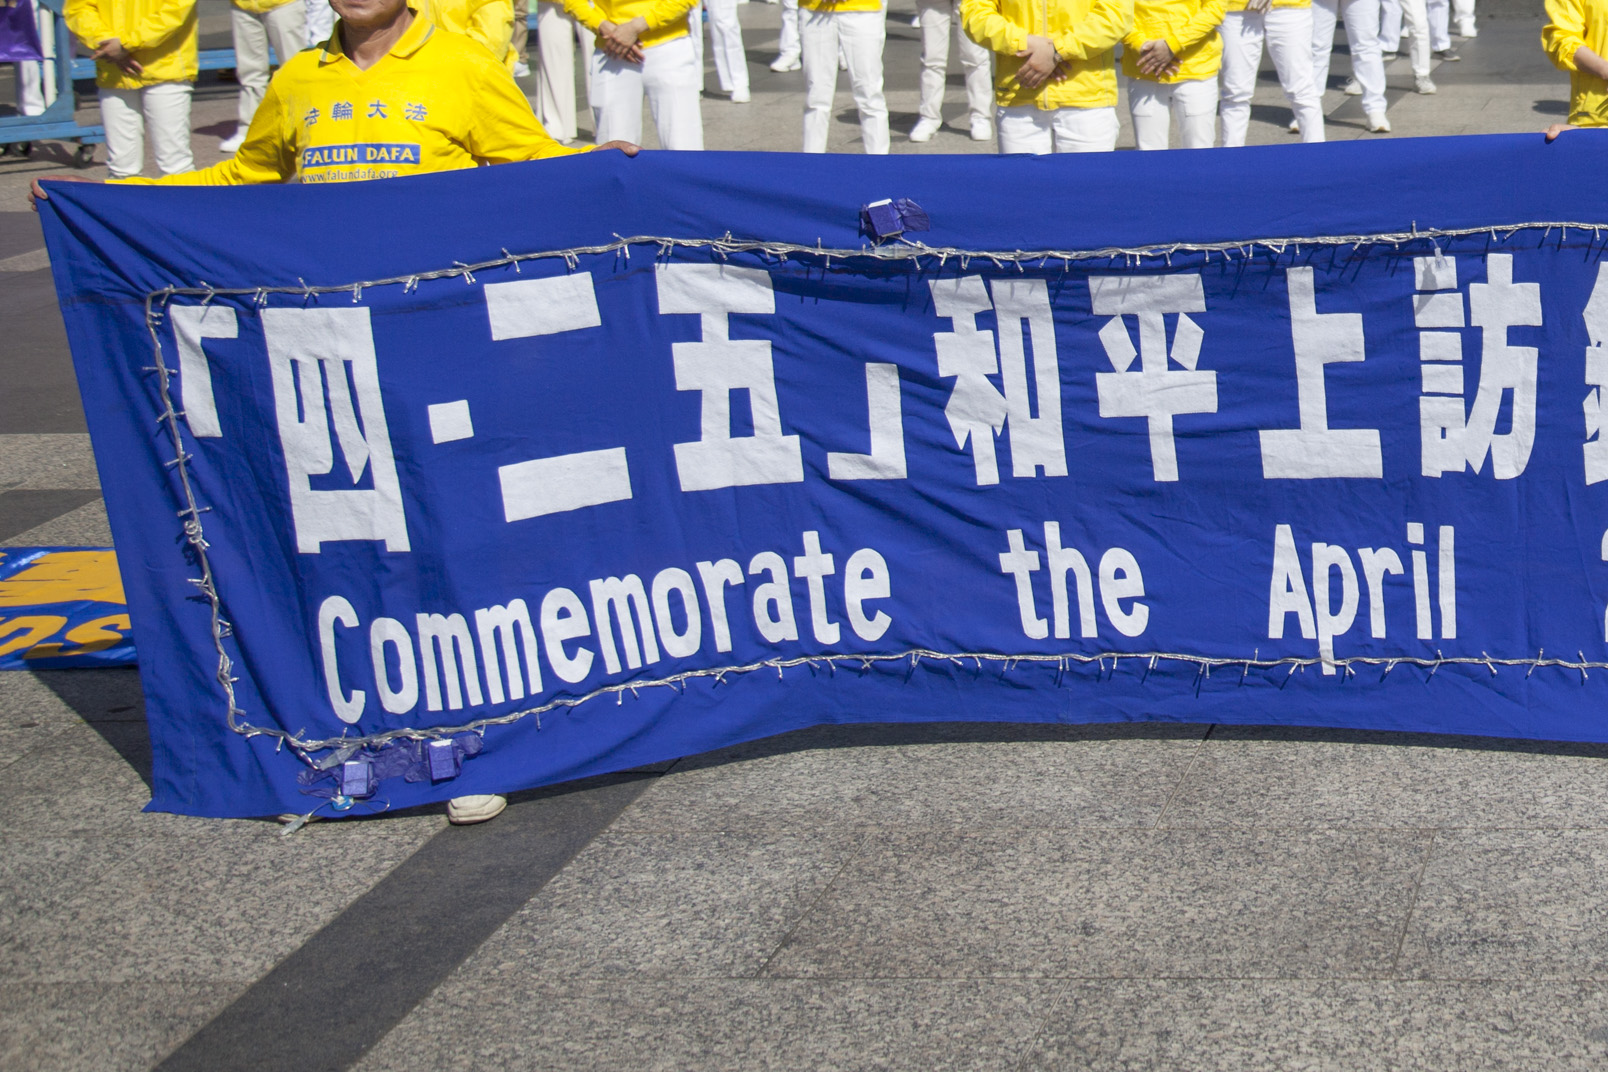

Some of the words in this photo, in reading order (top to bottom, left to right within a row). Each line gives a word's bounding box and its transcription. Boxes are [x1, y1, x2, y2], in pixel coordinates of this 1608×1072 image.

[304, 148, 358, 165] FALUN
[366, 147, 415, 161] DAFA
[317, 530, 892, 723] Commemorate
[999, 521, 1150, 639] the
[1268, 522, 1456, 676] April
